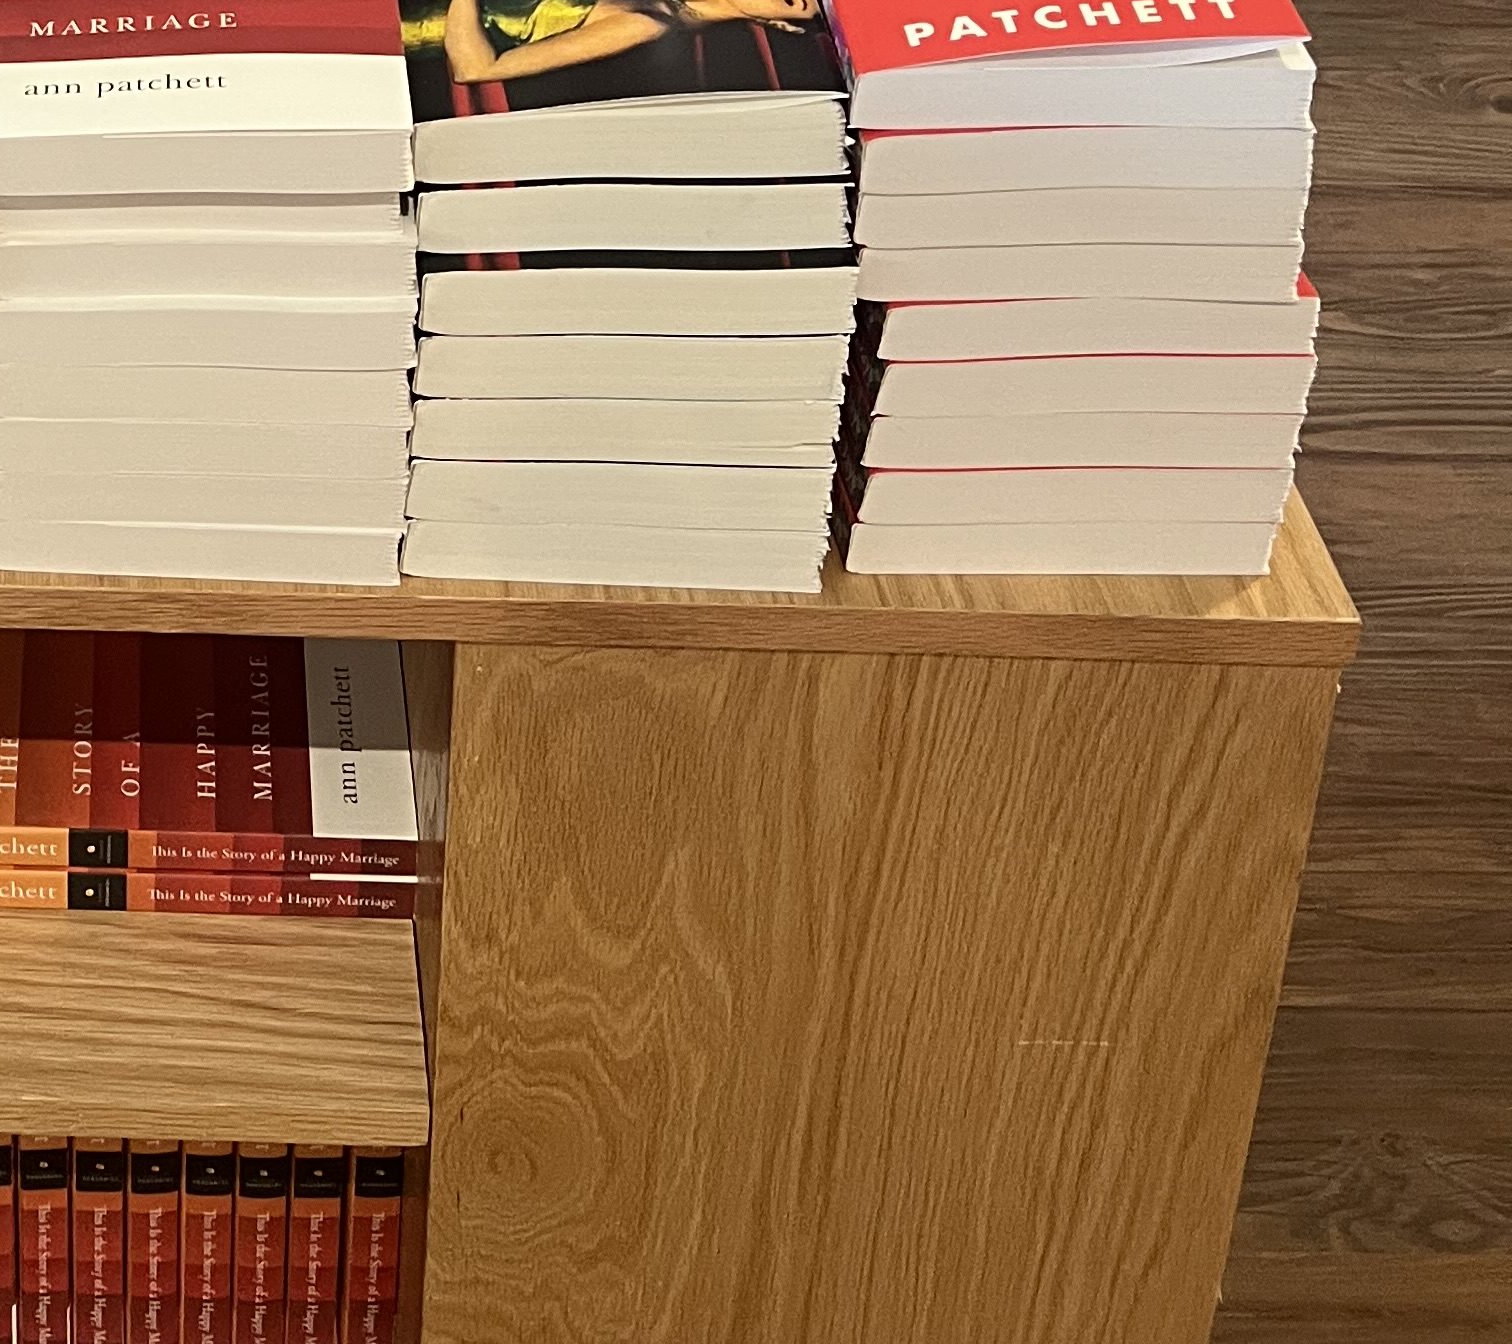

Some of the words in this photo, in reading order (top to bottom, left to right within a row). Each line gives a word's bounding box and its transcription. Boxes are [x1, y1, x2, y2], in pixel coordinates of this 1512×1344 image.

[29, 12, 240, 38] MARRIAGE
[24, 81, 83, 96] ann
[96, 73, 229, 98] patchett
[152, 845, 179, 862] This
[182, 847, 193, 860] Is
[195, 847, 218, 860] the
[222, 848, 257, 865] Story
[260, 848, 276, 862] of
[277, 853, 286, 862] a
[290, 850, 336, 867] Happy
[339, 851, 400, 868] Marriage
